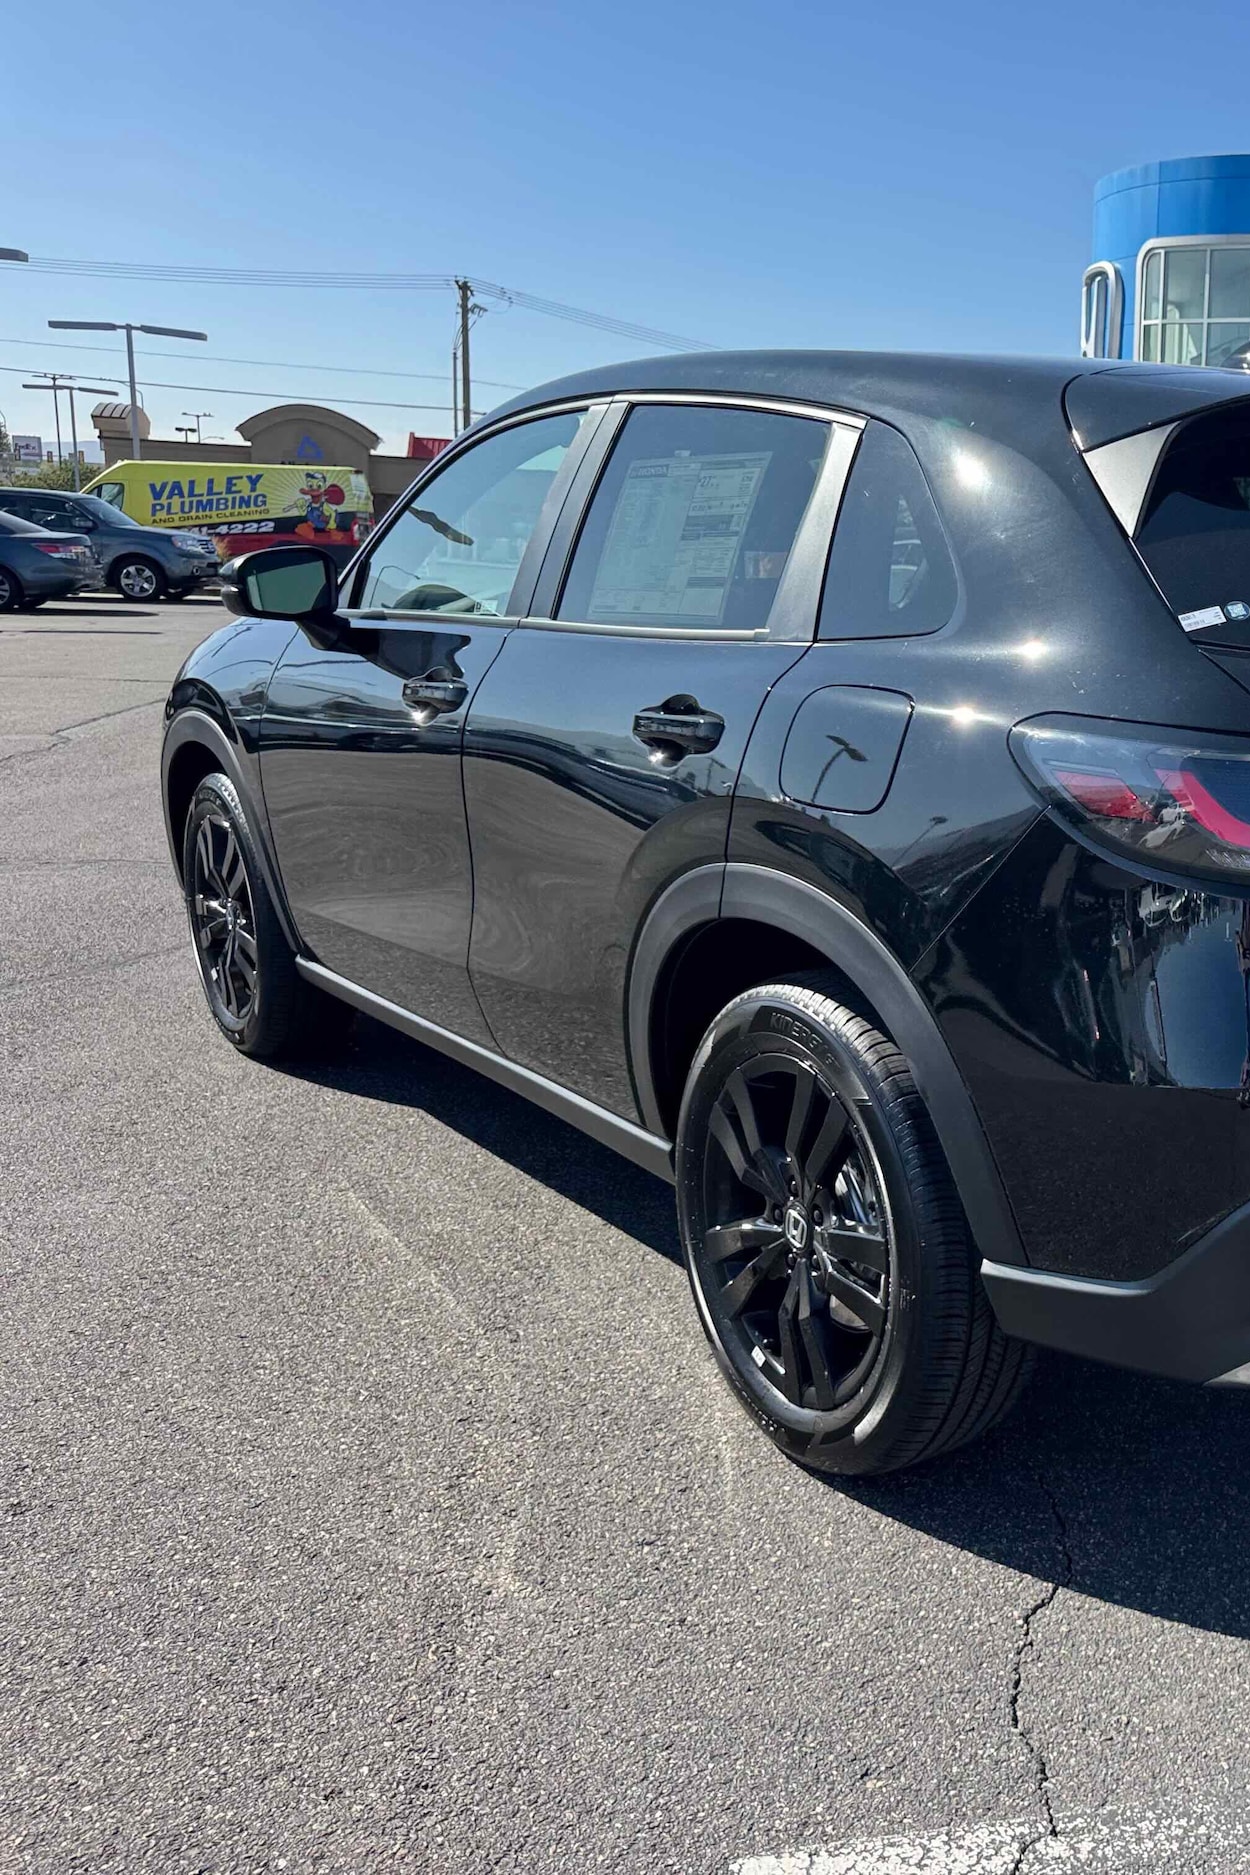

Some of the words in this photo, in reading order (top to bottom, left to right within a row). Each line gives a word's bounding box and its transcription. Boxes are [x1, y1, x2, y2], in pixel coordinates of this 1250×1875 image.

[148, 473, 264, 501] VALLEY
[151, 493, 267, 517] PLUMBING
[151, 516, 175, 525] AND
[178, 513, 213, 522] DRAIN
[216, 508, 270, 519] CLEANING
